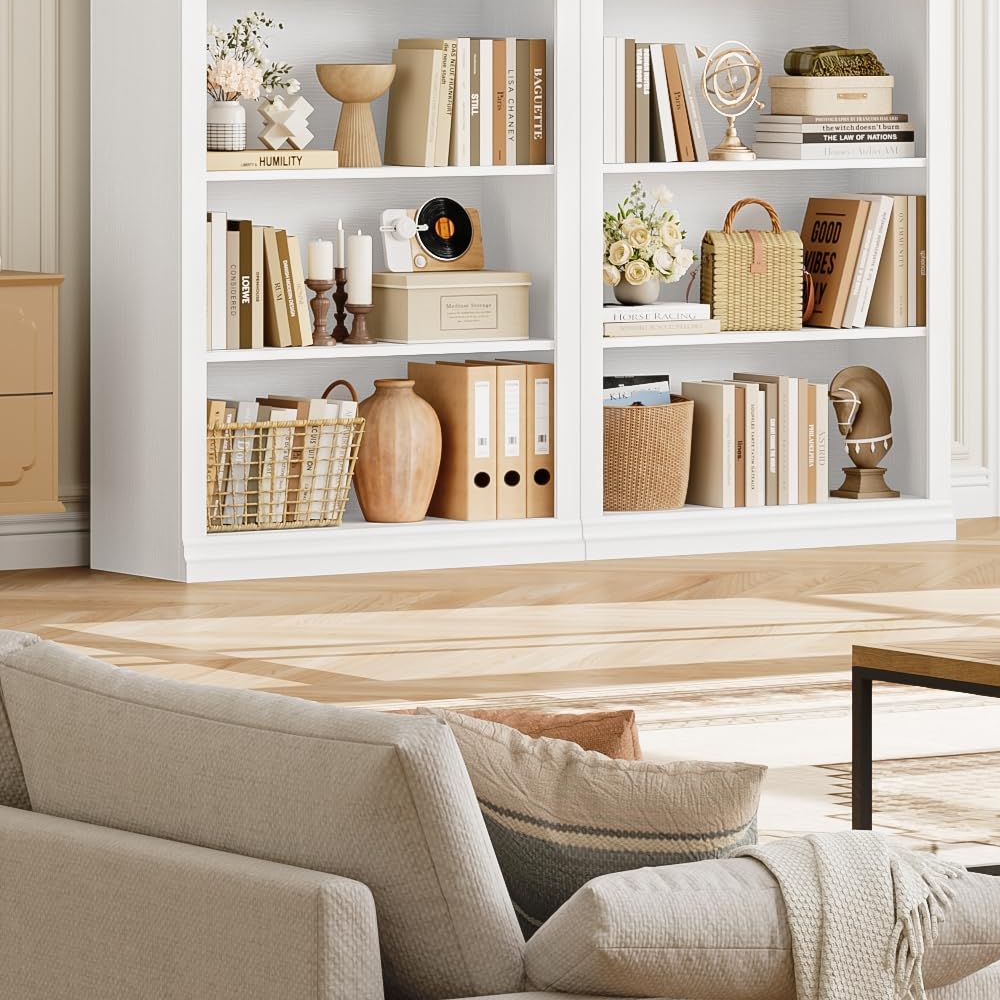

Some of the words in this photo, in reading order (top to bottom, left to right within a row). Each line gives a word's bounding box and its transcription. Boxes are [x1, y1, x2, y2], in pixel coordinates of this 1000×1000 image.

[534, 68, 543, 140] BAGUETTE
[259, 155, 302, 167] HUMILITY
[899, 212, 904, 223] ON
[811, 221, 842, 244] GOOD
[241, 275, 250, 304] LOEWE
[274, 282, 282, 302] RUM
[654, 312, 696, 320] RACING
